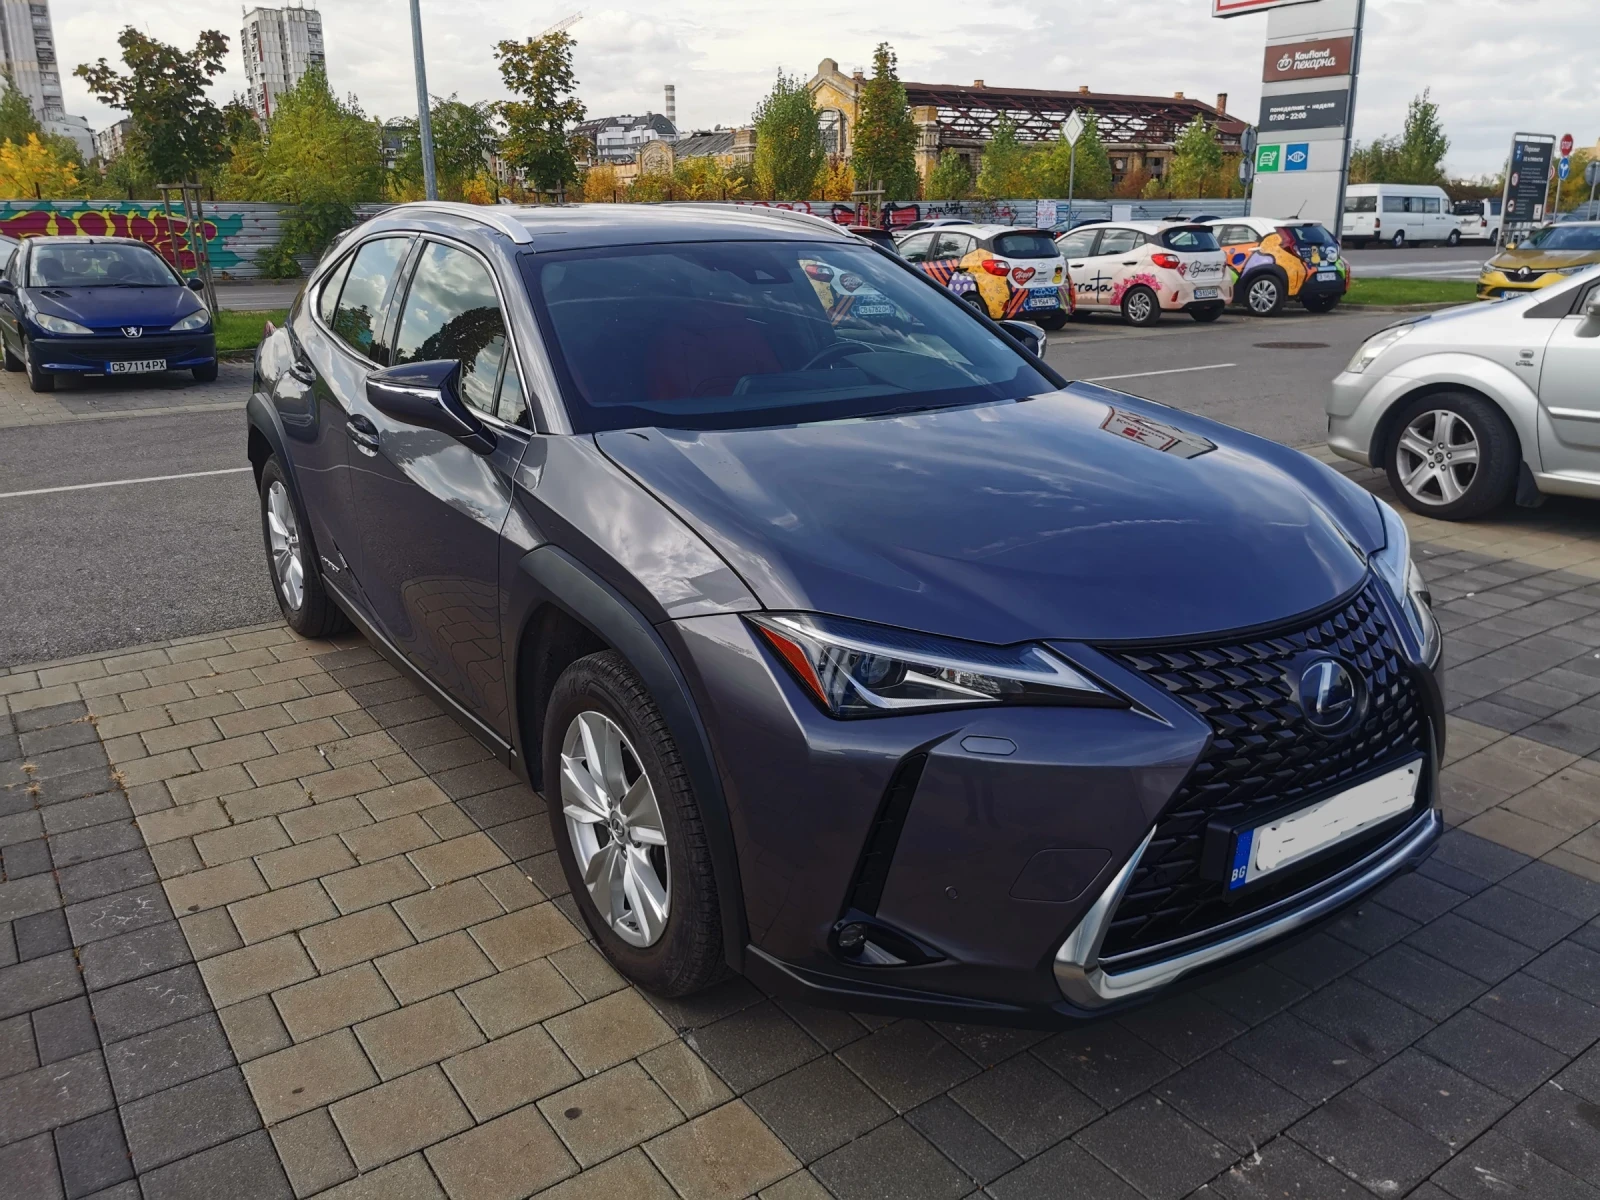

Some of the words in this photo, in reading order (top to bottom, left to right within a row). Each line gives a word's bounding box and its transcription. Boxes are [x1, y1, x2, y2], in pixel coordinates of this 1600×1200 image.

[1294, 48, 1330, 61] Kaufland
[1293, 57, 1336, 70] пекарна
[1269, 113, 1286, 121] 07:00
[1290, 112, 1307, 120] 22:00
[1561, 141, 1572, 149] STOP
[1231, 865, 1246, 882] BG
